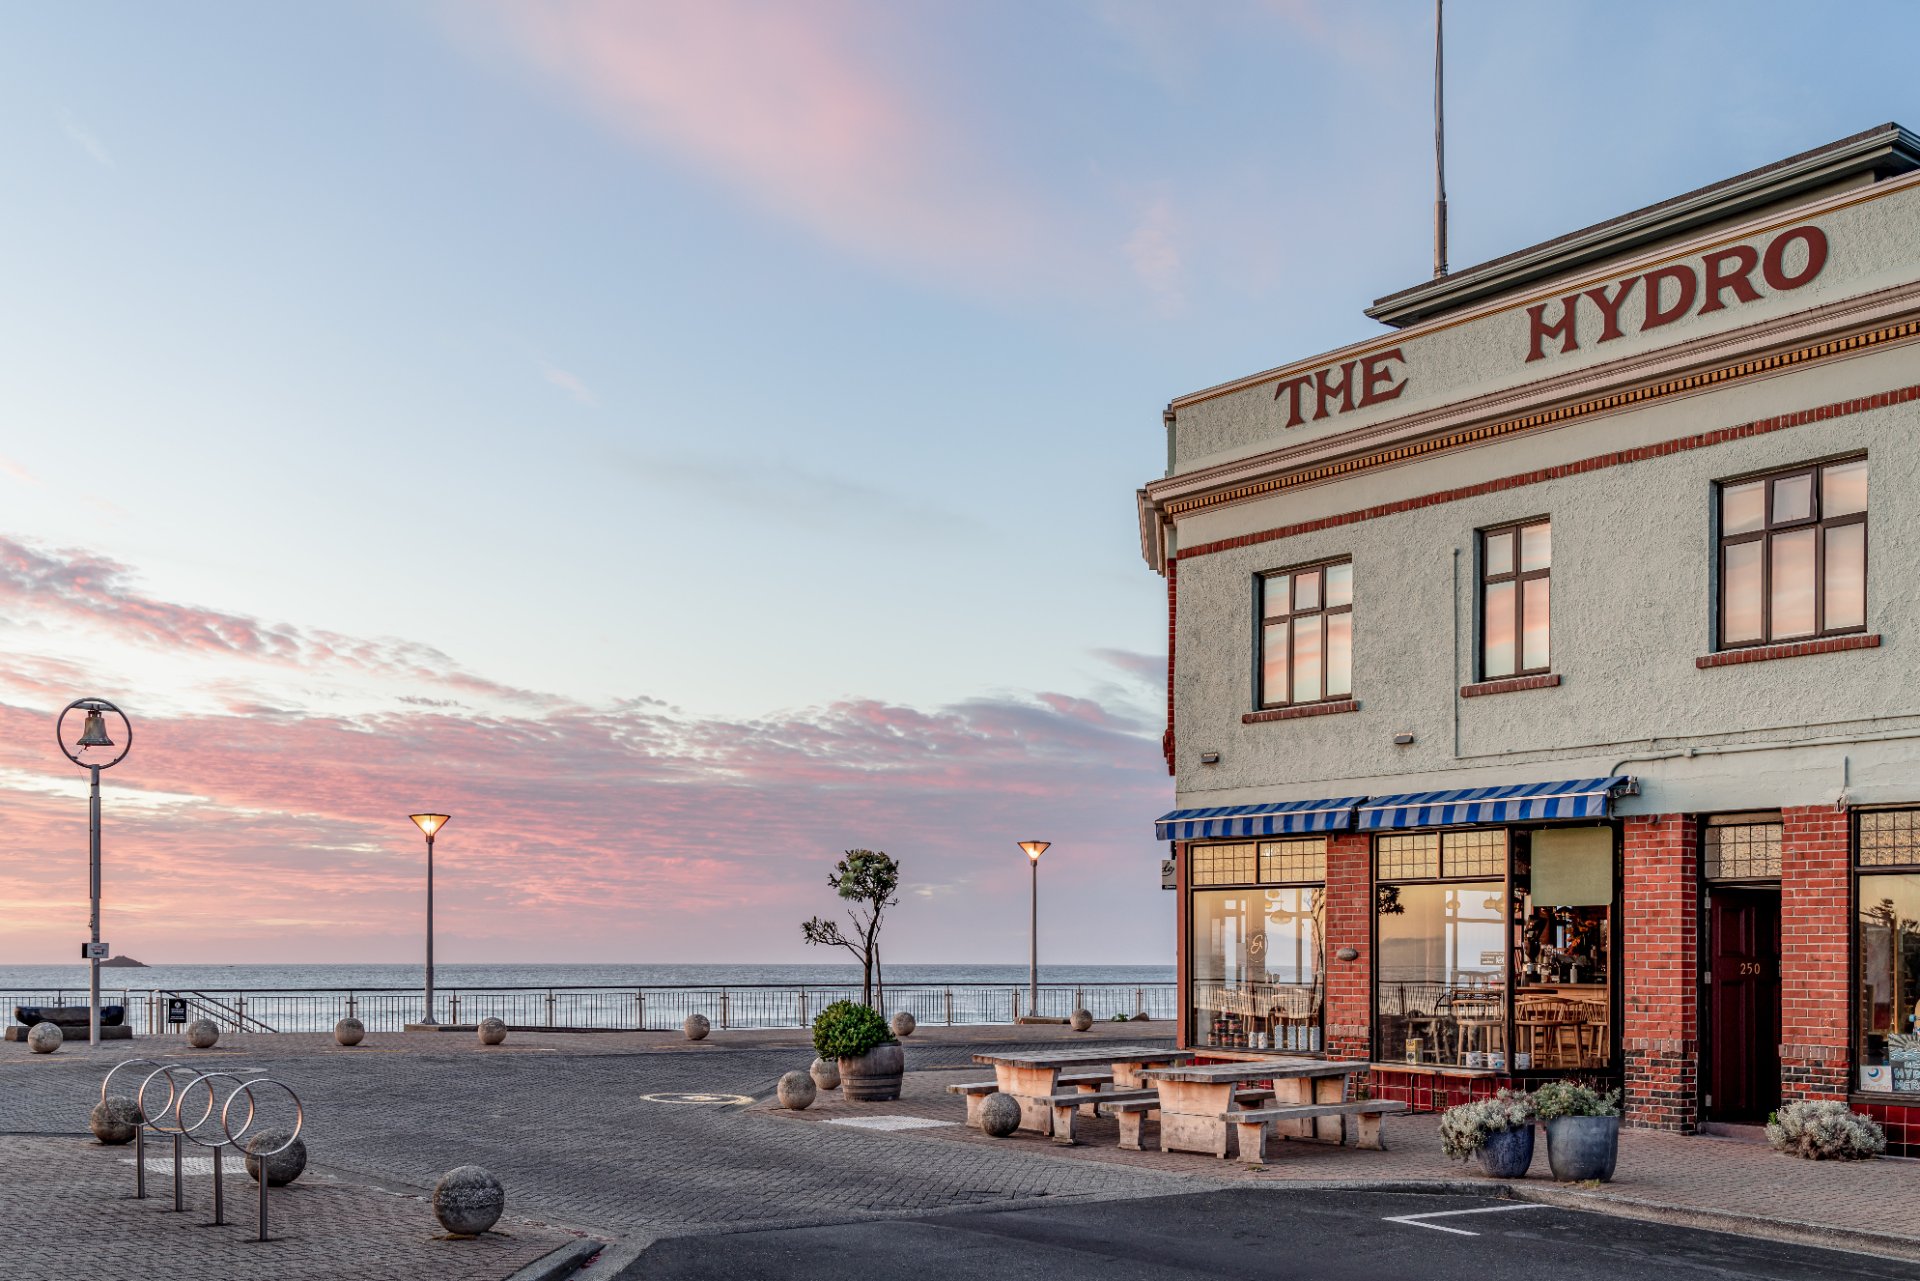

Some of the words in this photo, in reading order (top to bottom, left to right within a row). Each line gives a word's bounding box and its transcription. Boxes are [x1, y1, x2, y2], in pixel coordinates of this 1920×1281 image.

[1274, 347, 1409, 428] THE
[1525, 225, 1828, 363] HYDRO
[1740, 962, 1760, 975] 250
